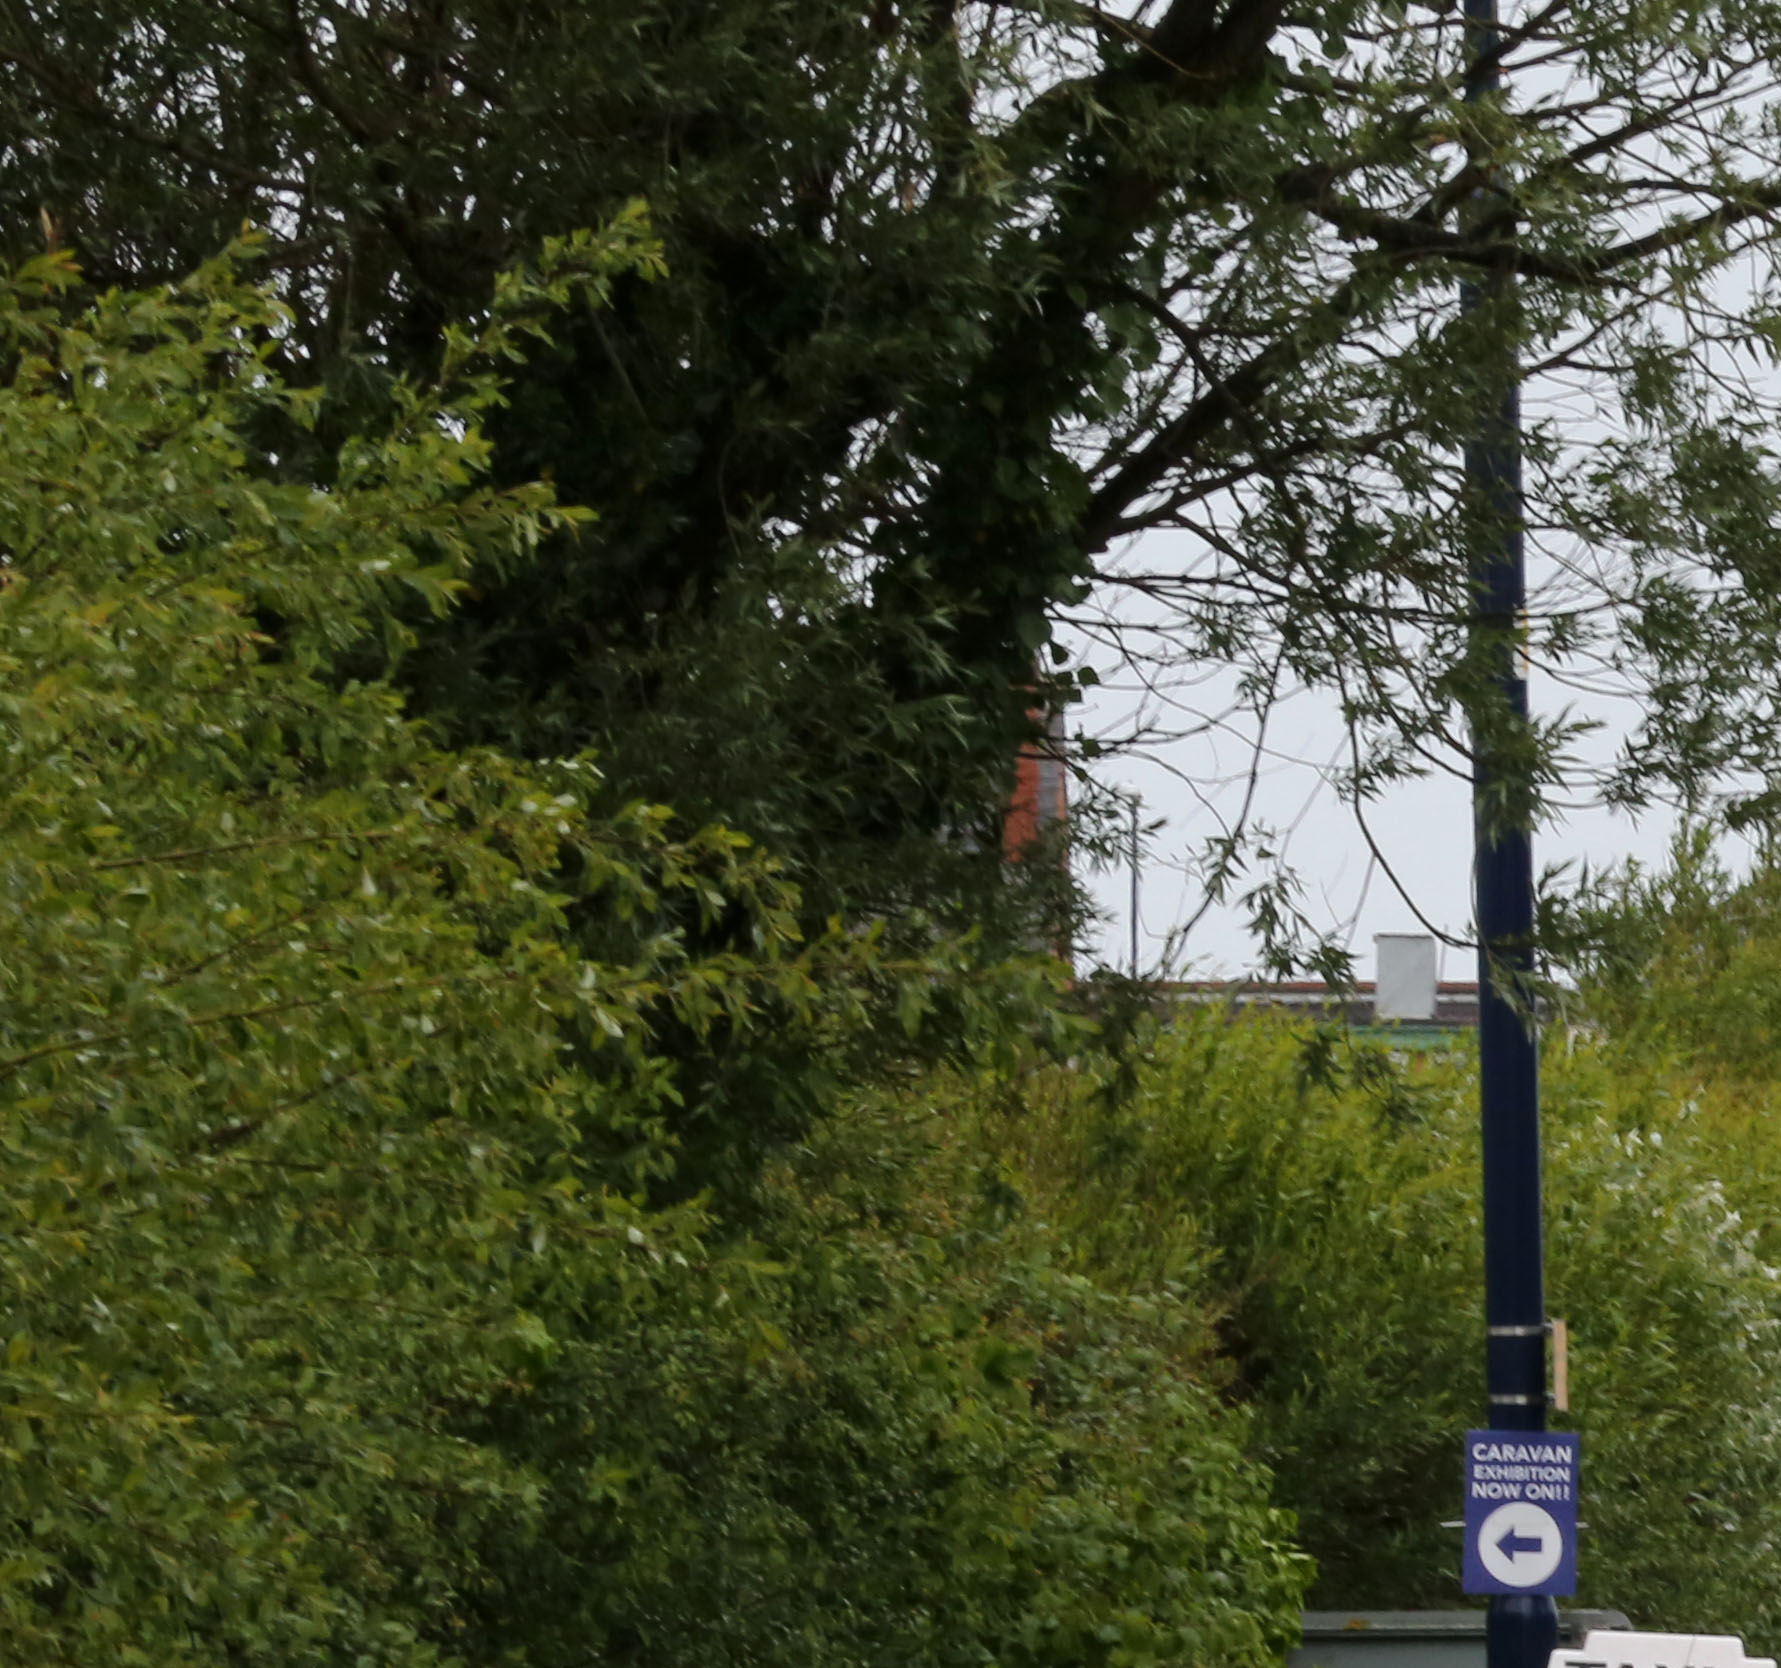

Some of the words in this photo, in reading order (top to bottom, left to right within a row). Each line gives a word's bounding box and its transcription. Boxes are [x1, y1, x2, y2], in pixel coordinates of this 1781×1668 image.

[1472, 1443, 1572, 1465] CARAVAN
[1473, 1464, 1571, 1483] EXHIBITION
[1471, 1482, 1522, 1500] NOW
[1525, 1482, 1571, 1501] ON!!
